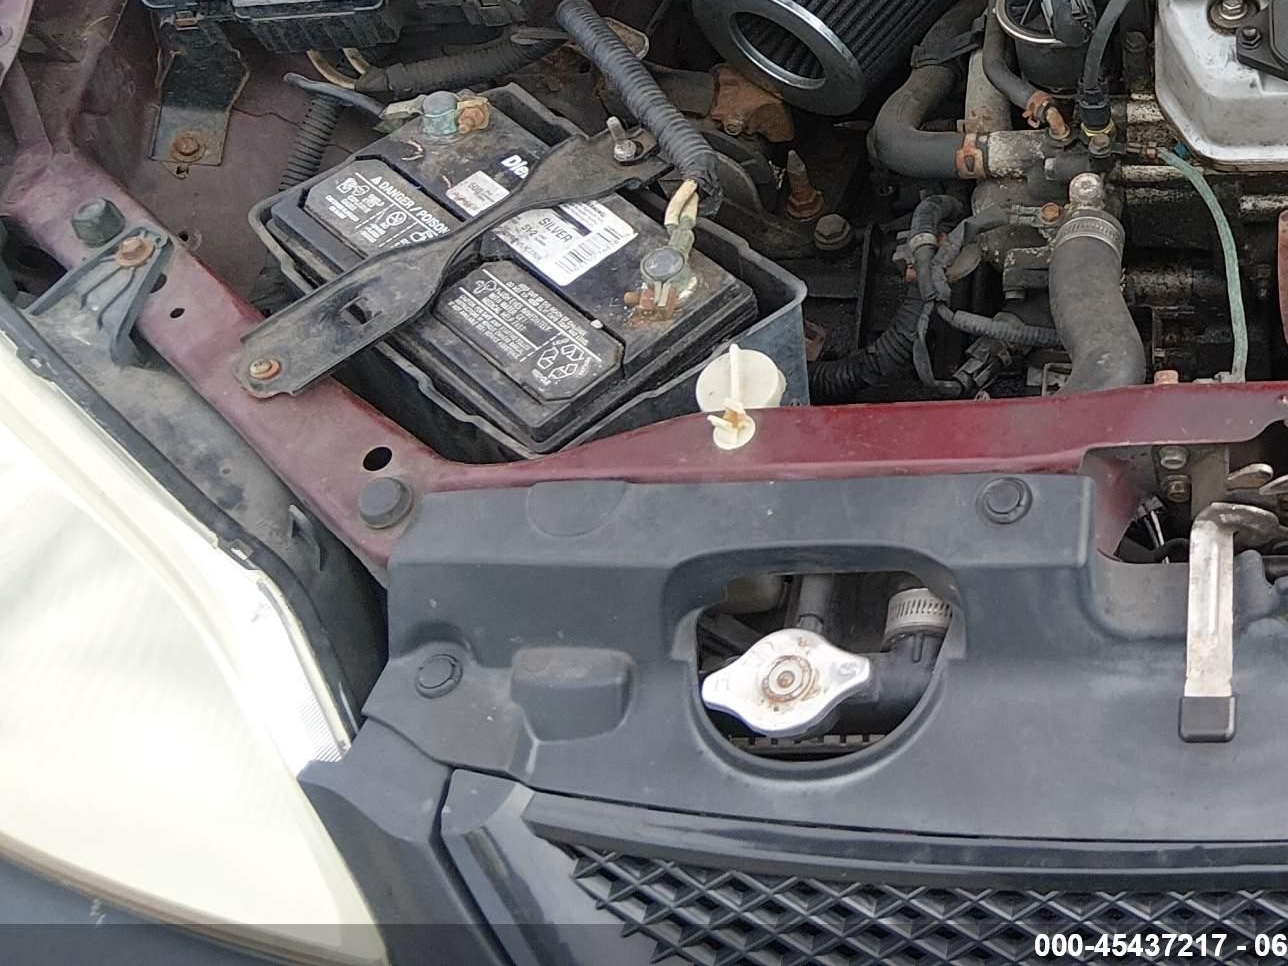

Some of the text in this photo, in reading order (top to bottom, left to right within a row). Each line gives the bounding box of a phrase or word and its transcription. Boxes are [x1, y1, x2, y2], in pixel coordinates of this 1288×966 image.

[378, 181, 415, 209] DANGER
[416, 209, 450, 234] POISON
[538, 217, 573, 243] SILVER
